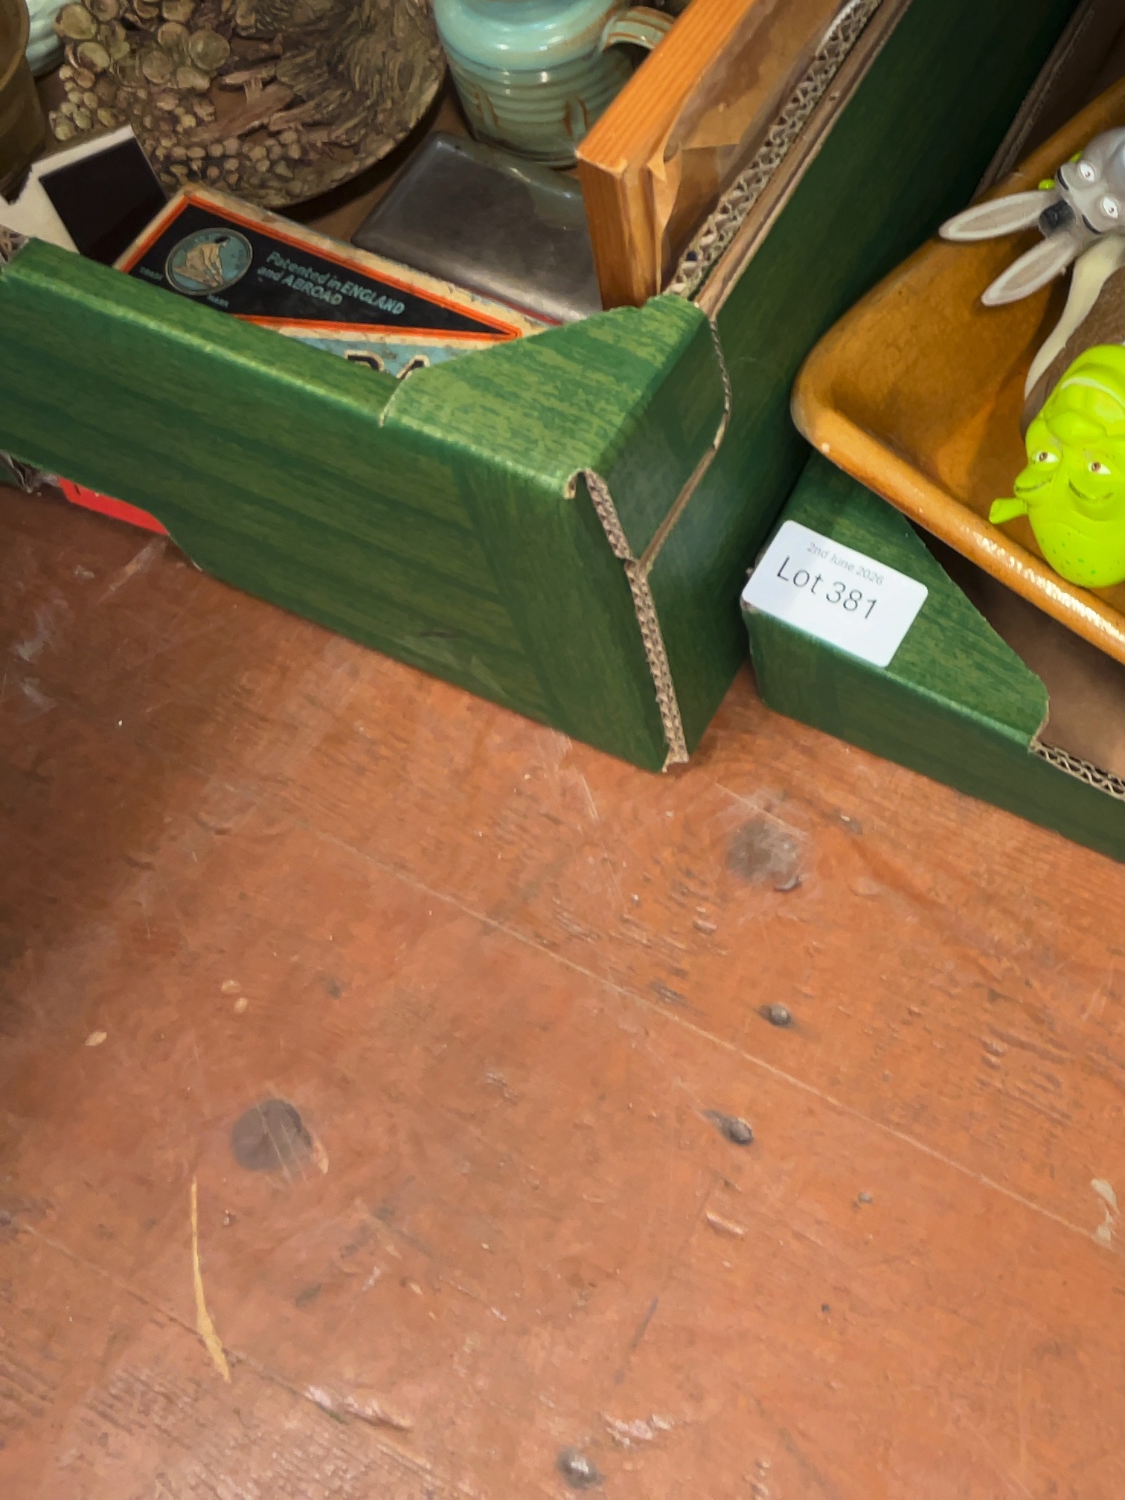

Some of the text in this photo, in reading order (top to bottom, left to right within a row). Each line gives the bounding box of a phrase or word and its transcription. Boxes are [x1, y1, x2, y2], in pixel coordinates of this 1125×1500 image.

[257, 266, 344, 306] and ABROAD
[266, 251, 406, 315] Patented in ENGLAND
[777, 555, 877, 620] Lot 381
